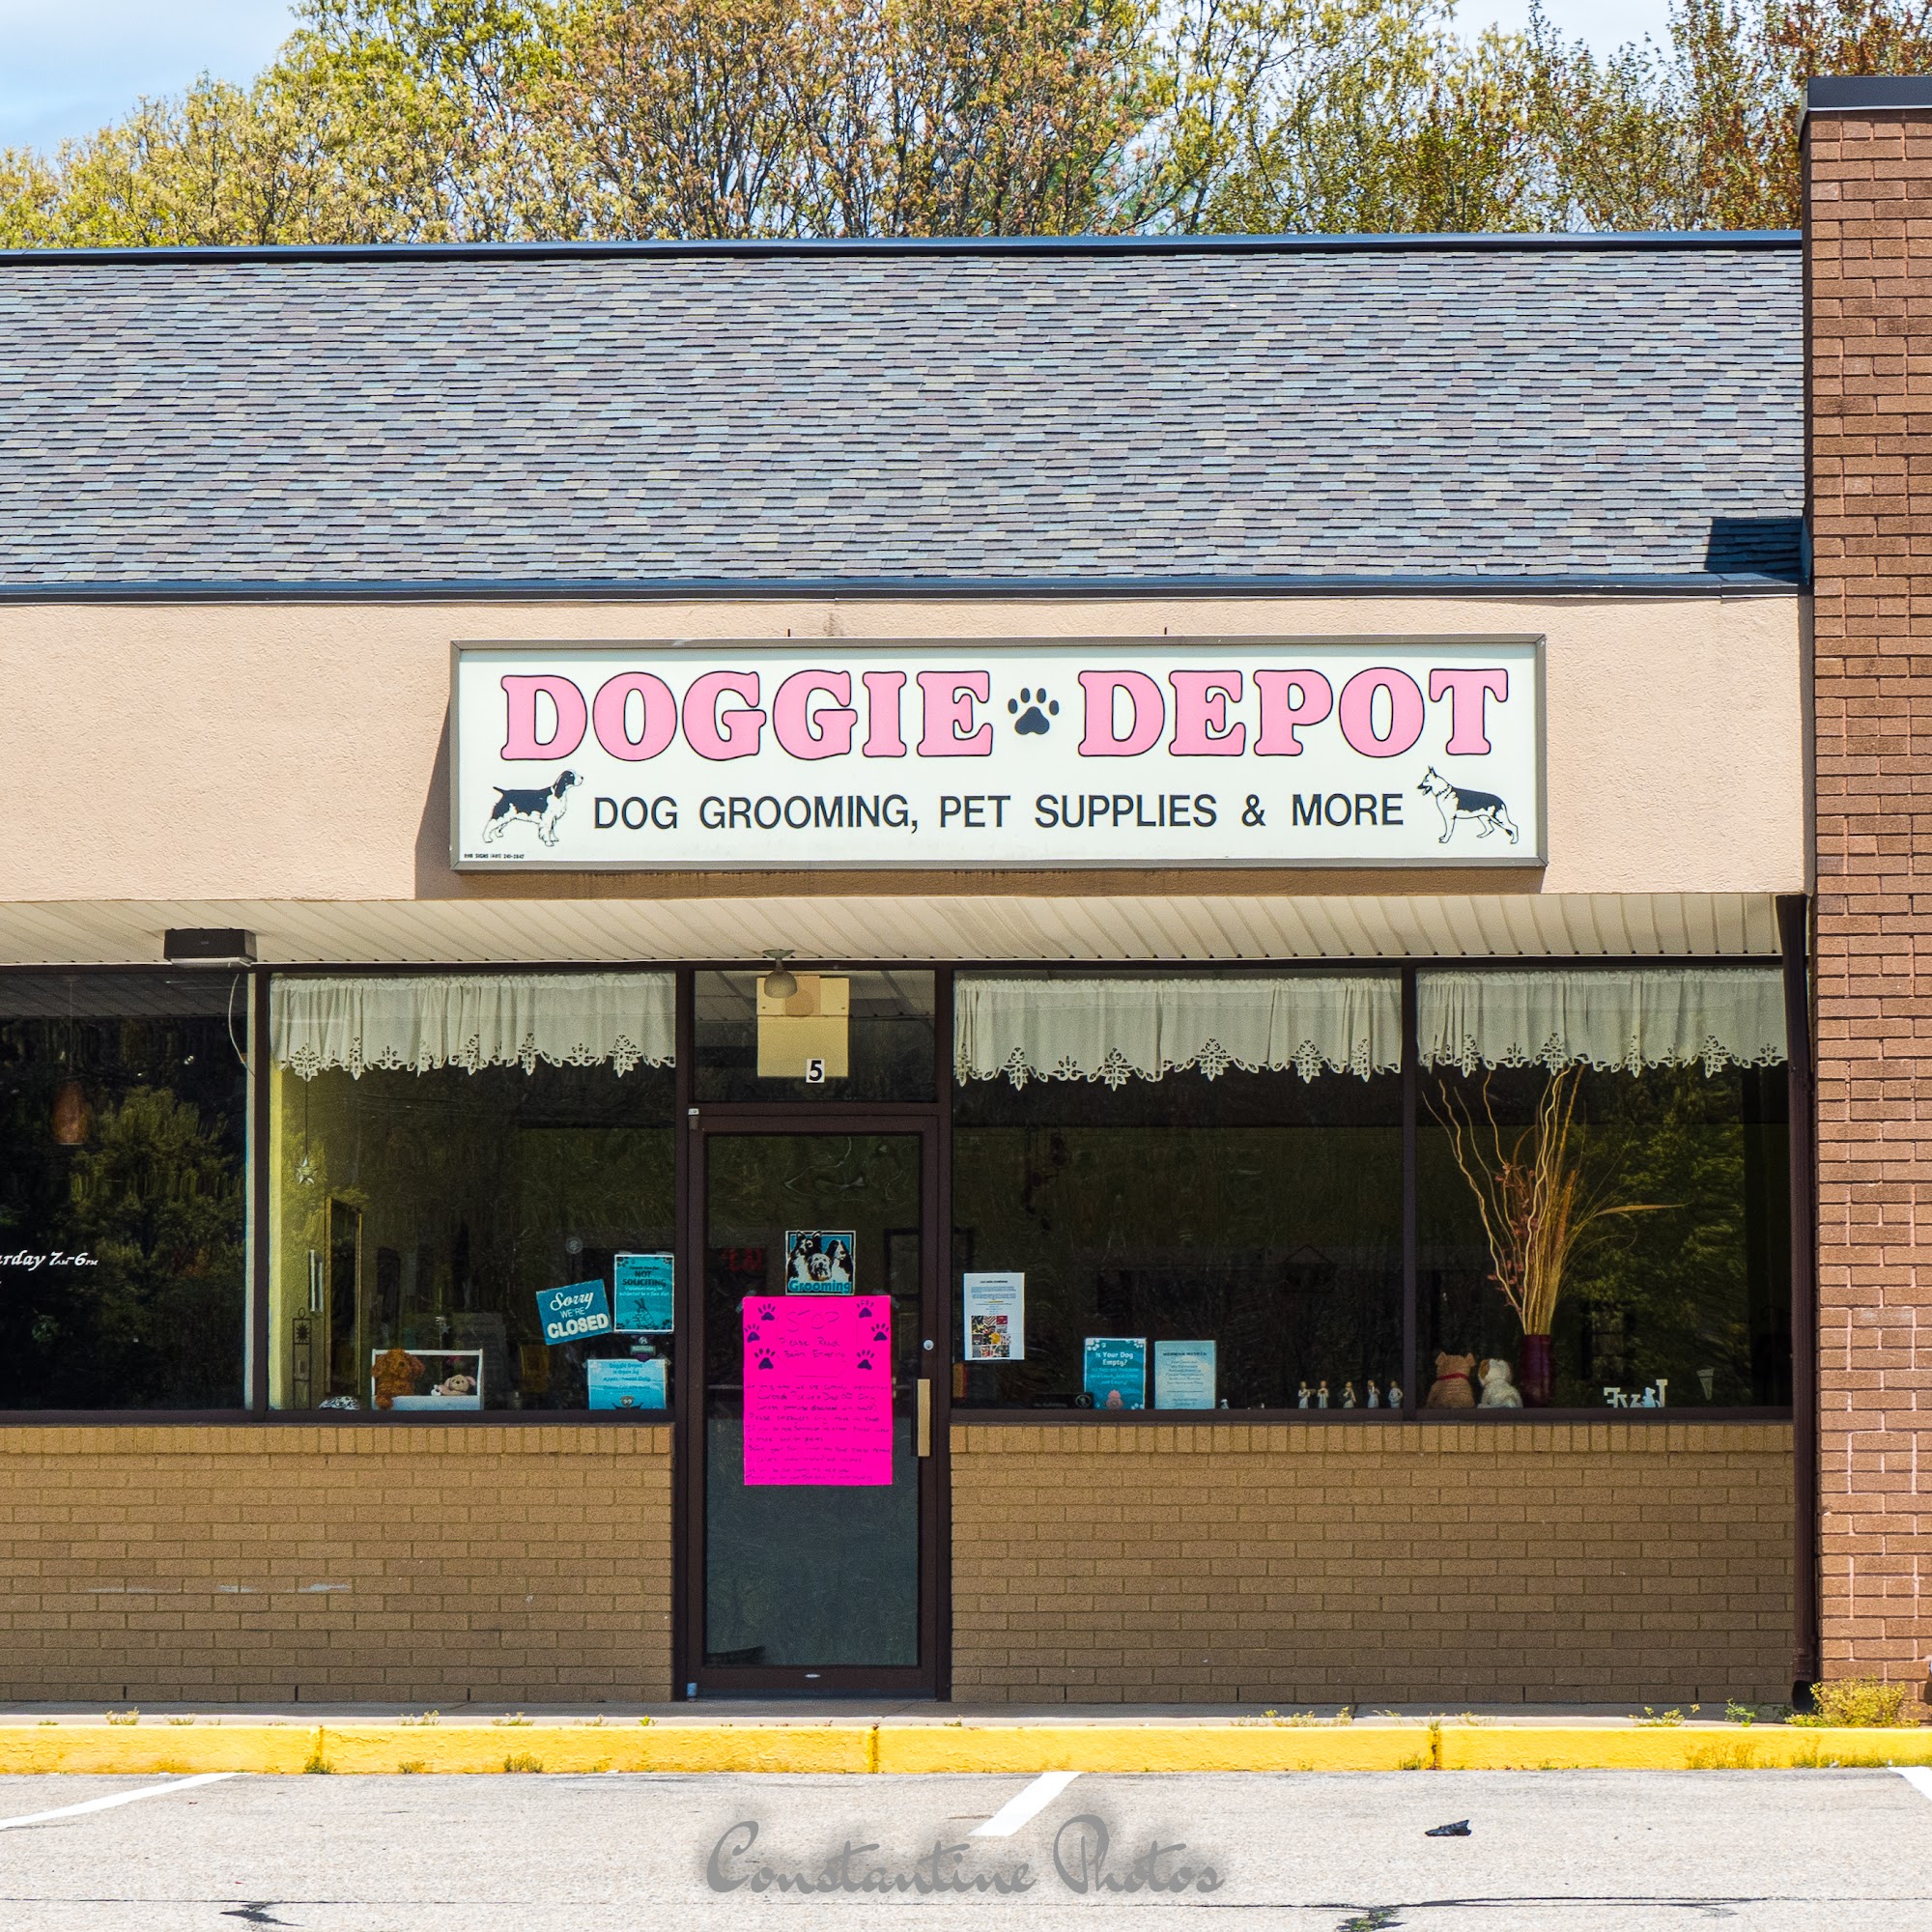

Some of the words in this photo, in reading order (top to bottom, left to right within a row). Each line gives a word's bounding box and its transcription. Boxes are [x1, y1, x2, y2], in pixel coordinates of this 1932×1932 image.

[500, 669, 993, 761] DOGGIE
[1078, 668, 1508, 758] DEPOT
[595, 796, 676, 829] DOG
[700, 795, 917, 833] GROOMING,
[941, 796, 1010, 827] PET
[1036, 794, 1216, 828] SUPPLIES
[1242, 795, 1265, 826] &
[1293, 794, 1403, 826] MORE
[809, 1060, 822, 1081] 5
[788, 1280, 851, 1294] Grooming
[550, 1292, 594, 1312] Sorry
[559, 1307, 585, 1319] WE'RE
[547, 1313, 610, 1339] CLOSED
